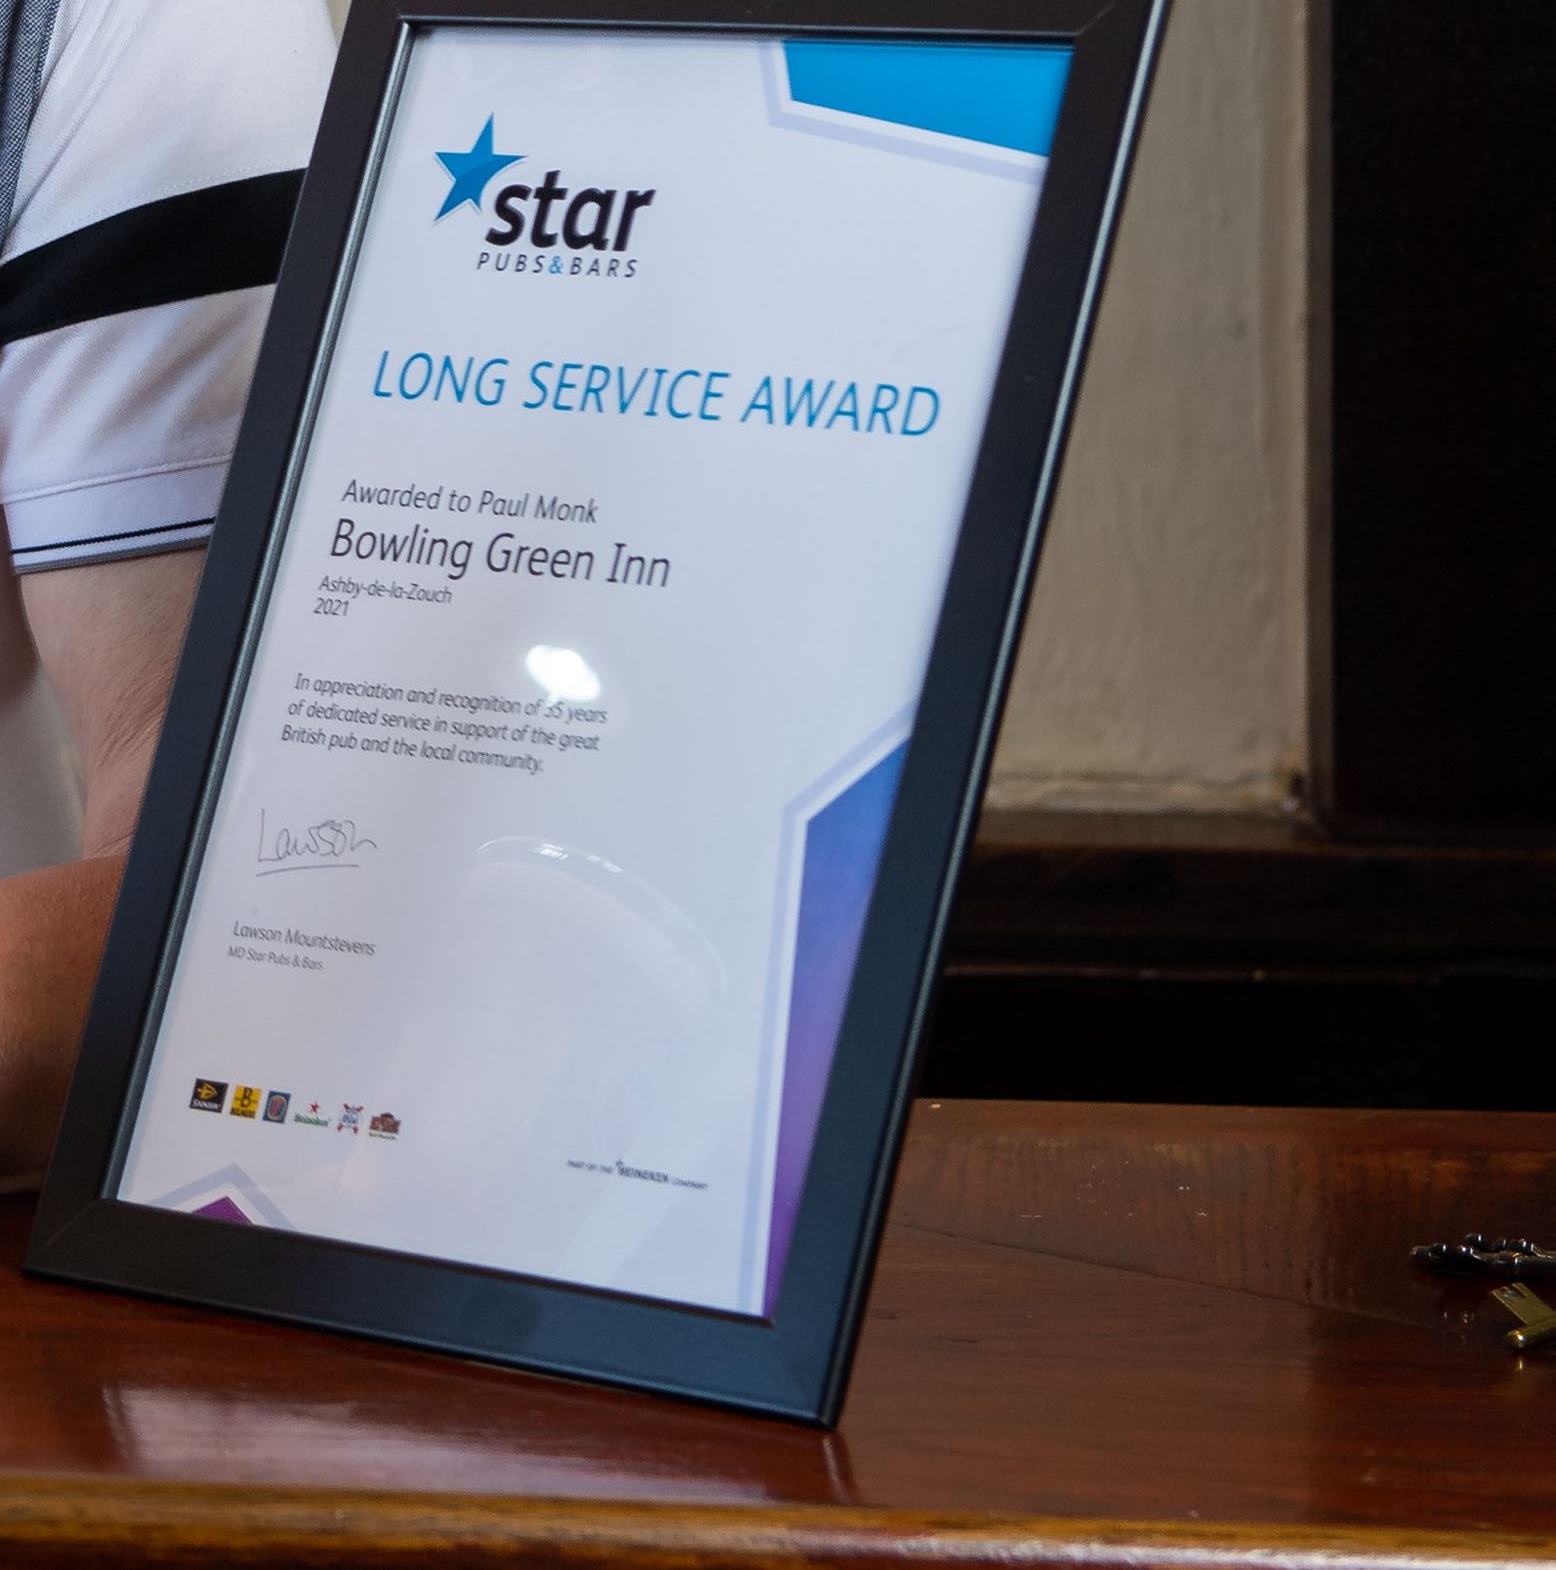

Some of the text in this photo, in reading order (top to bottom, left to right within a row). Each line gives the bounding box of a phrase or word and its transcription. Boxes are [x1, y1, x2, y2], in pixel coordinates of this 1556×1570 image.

[485, 169, 656, 253] star
[372, 349, 942, 437] LONG SERVICE AWARD
[341, 478, 599, 524] Awarded to Paul Monk
[329, 517, 672, 588] Bowling Green Inn
[313, 597, 351, 618] 2021
[317, 574, 453, 604] Ashby-de-la-Zouch
[295, 673, 311, 691] In
[313, 676, 404, 702] appreciation
[407, 688, 437, 706] and
[439, 690, 521, 716] recognition
[524, 698, 543, 717] of
[564, 707, 608, 725] years
[282, 724, 326, 747] British
[328, 730, 358, 751] pub
[360, 735, 389, 755] and
[393, 737, 418, 757] the
[420, 741, 456, 762] local
[288, 698, 601, 752] of dedicated service in support of the great
[232, 919, 377, 957] Lawson Mountstevens
